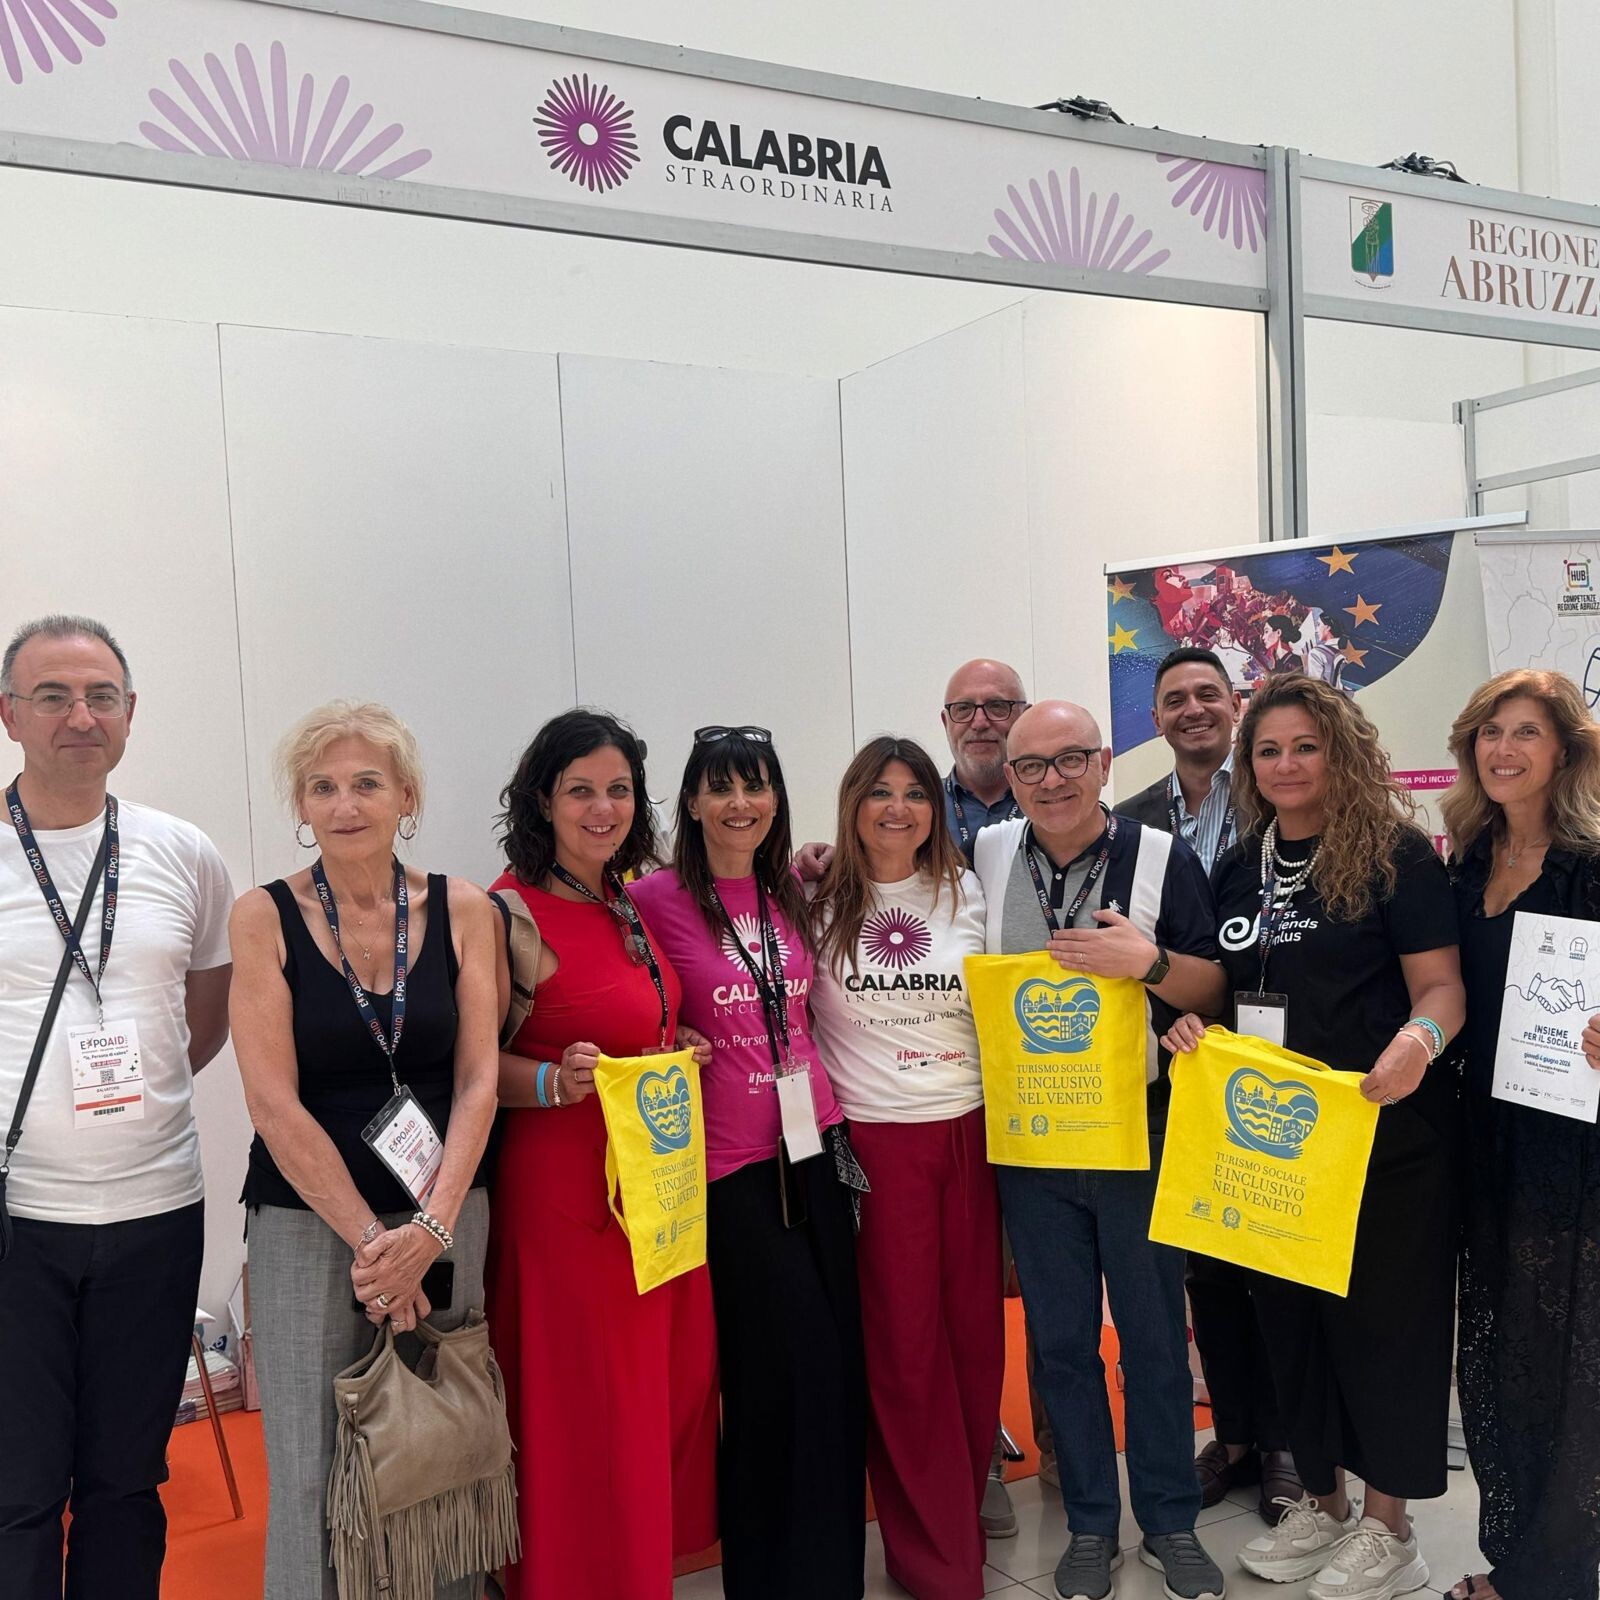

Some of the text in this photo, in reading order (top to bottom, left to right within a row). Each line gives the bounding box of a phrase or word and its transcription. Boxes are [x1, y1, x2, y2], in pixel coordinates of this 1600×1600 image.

[663, 114, 891, 190] CALABRIA
[666, 164, 893, 213] STRAORDINARIA
[1467, 218, 1600, 269] REGIONE
[1440, 255, 1600, 317] ABRUZZ
[1571, 571, 1586, 581] HUB
[1557, 602, 1600, 611] REGIONE ABRUZZ
[1563, 594, 1597, 603] COMPETENZE
[1429, 775, 1458, 784] INCLUS
[845, 974, 963, 991] CALABRIA
[713, 979, 808, 1005] CALRIA
[845, 992, 962, 1003] INCLUSIVA
[713, 997, 806, 1018] INCLIA
[924, 1011, 936, 1023] di
[733, 1033, 772, 1047] Perso
[1535, 1024, 1569, 1039] INSIEME
[1524, 1031, 1537, 1041] PER
[1539, 1035, 1545, 1043] IL
[1547, 1037, 1579, 1050] SOCIALE
[1016, 1063, 1102, 1074] TURISMO SOCIALE
[1017, 1076, 1102, 1089] E INCLUSIVO
[1017, 1092, 1103, 1105] NEL VENETO
[651, 1162, 680, 1179] TURISMO
[1215, 1152, 1307, 1186] TURISMO SOCIALE
[655, 1168, 698, 1196] E INCLUSIVO
[1214, 1164, 1304, 1201] E INCLUSIVO
[659, 1196, 677, 1214] NEL
[1212, 1179, 1240, 1199] NEL
[1242, 1189, 1302, 1217] VENETO
